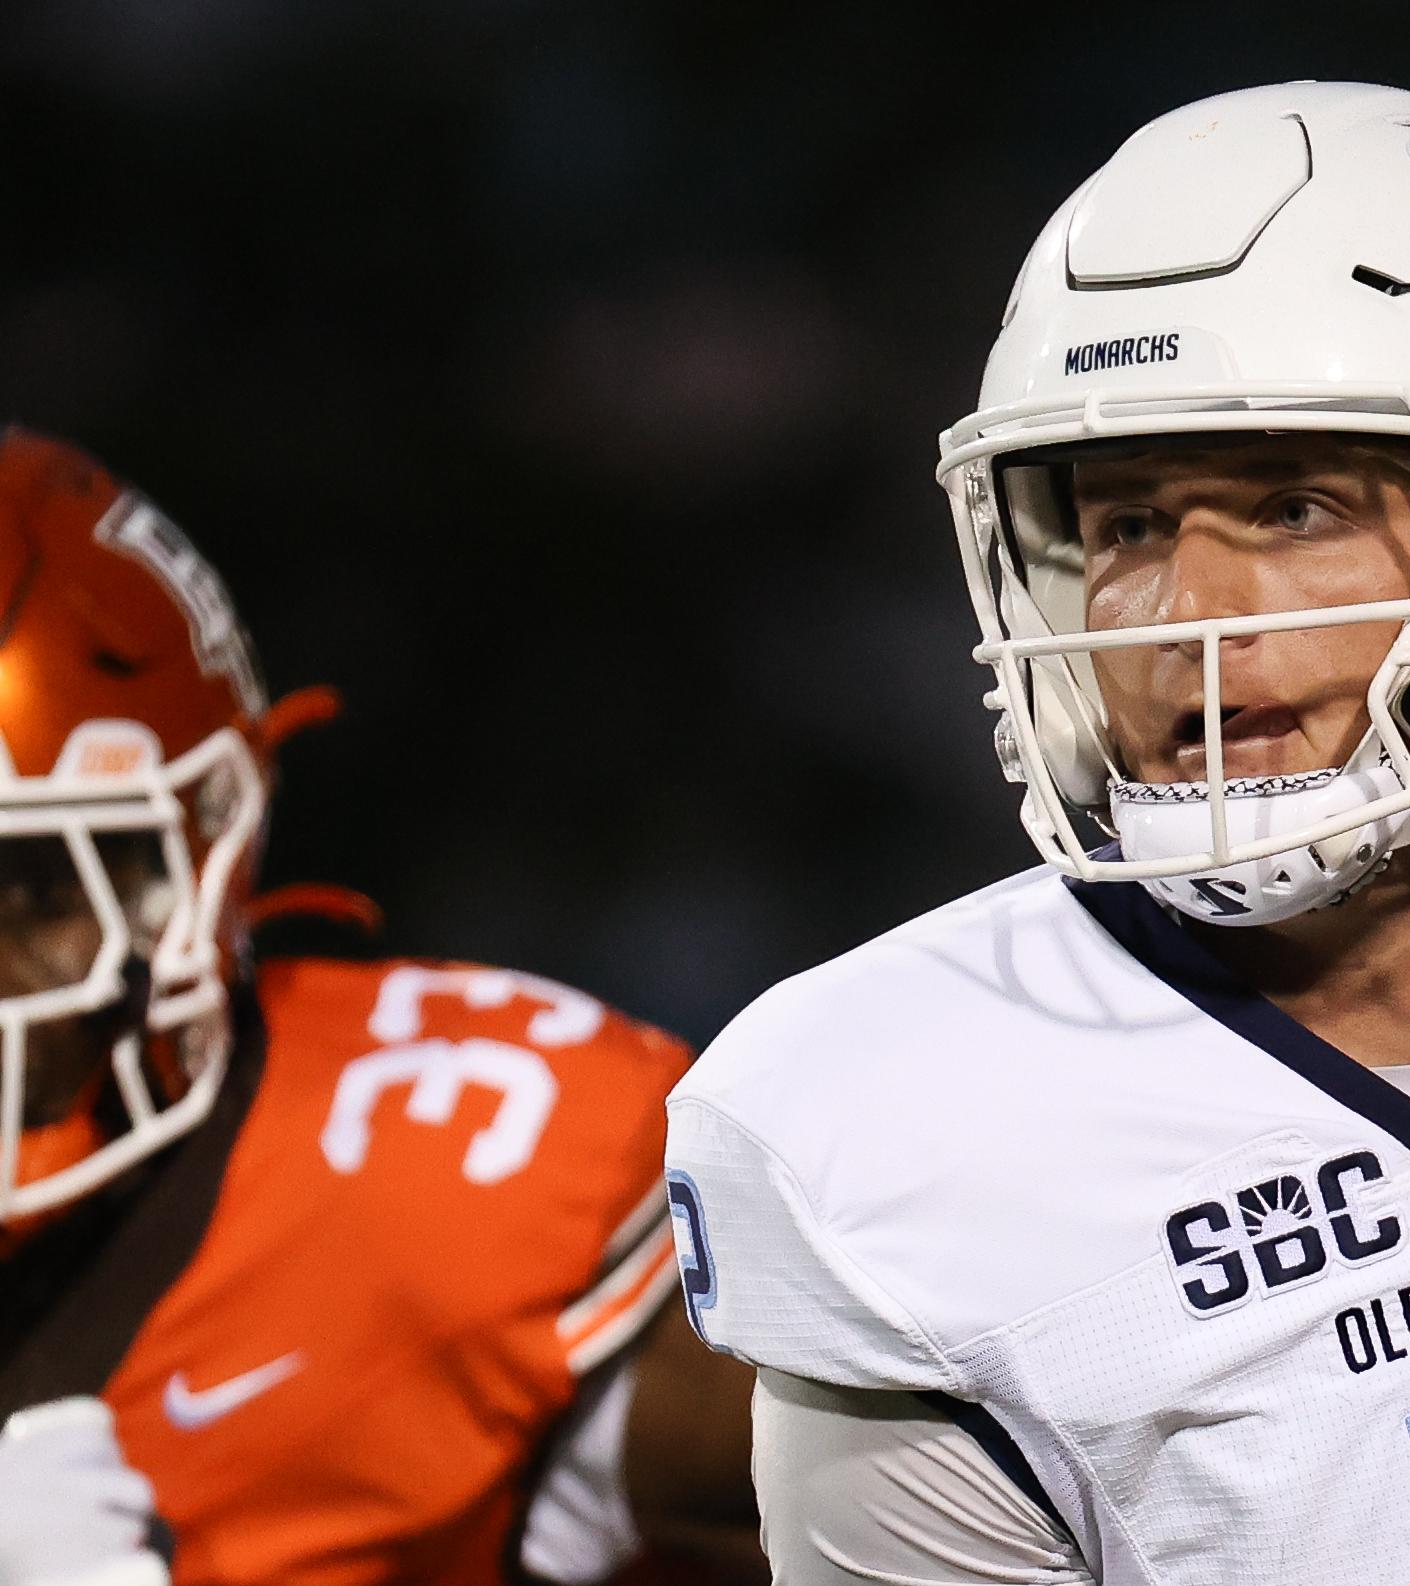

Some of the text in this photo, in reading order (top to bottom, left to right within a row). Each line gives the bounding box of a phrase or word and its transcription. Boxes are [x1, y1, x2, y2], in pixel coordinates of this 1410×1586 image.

[1064, 333, 1180, 376] MONARCHS
[319, 965, 602, 1185] 33
[1164, 1148, 1402, 1315] SBC
